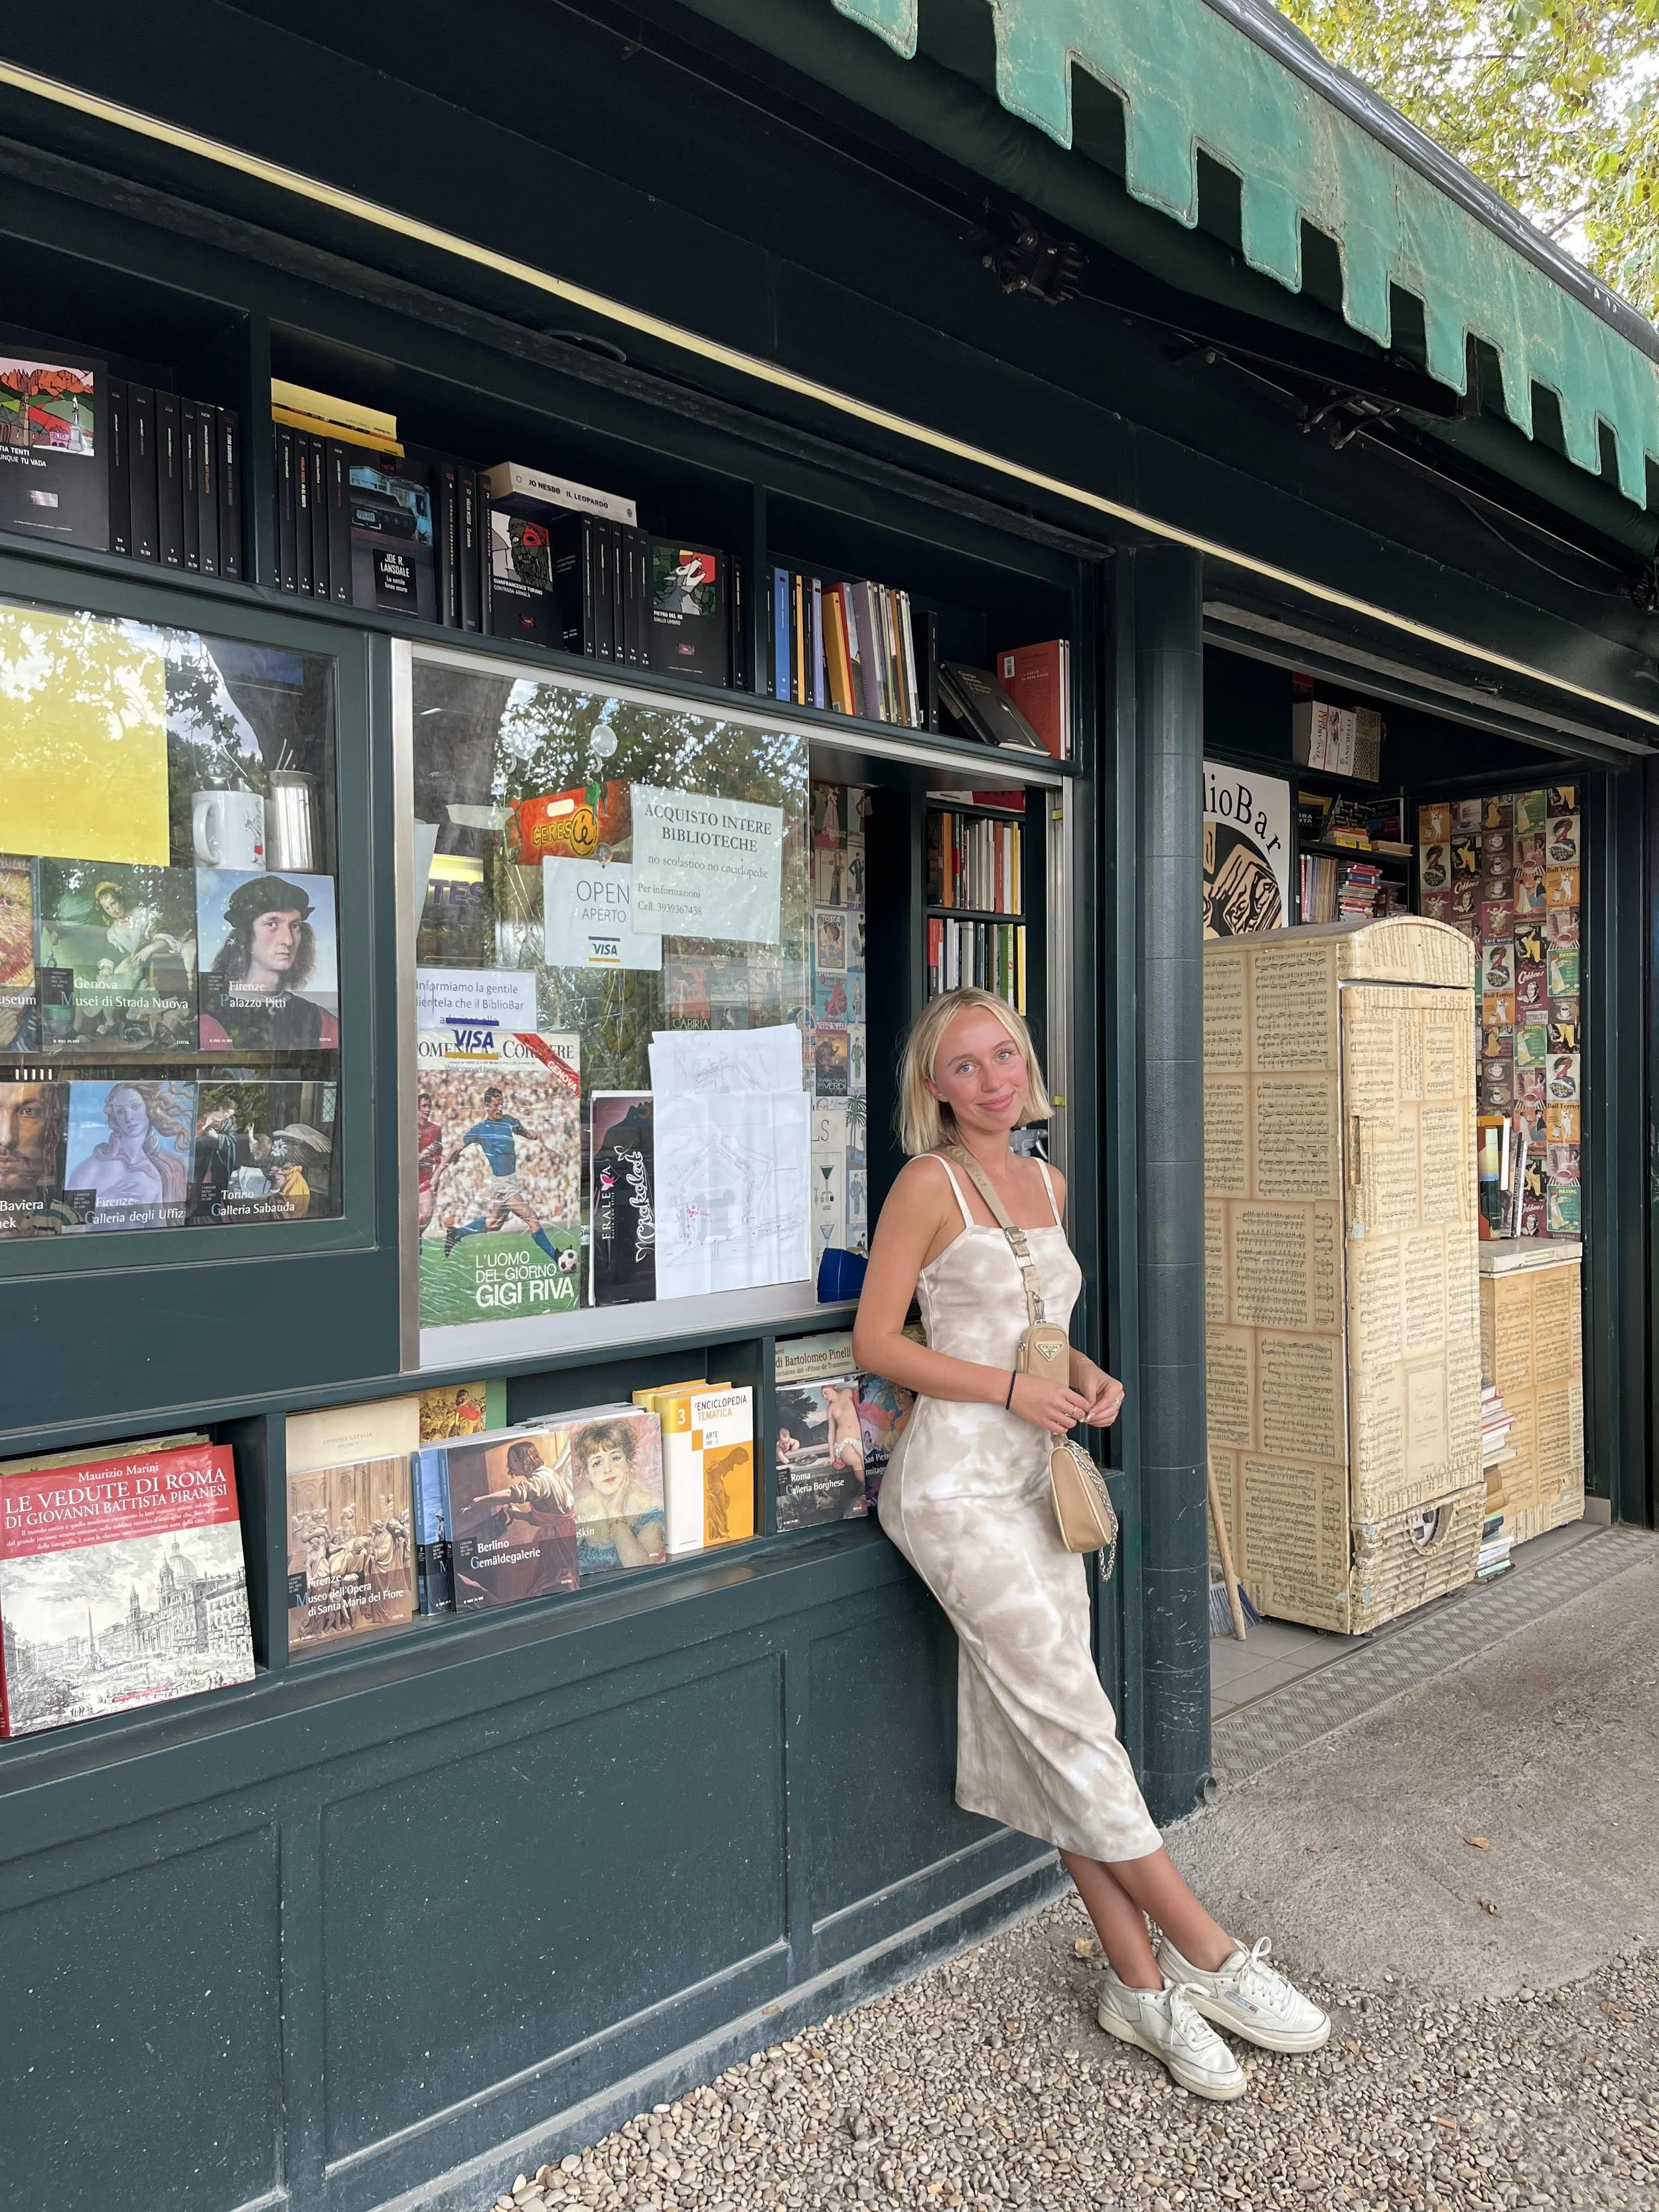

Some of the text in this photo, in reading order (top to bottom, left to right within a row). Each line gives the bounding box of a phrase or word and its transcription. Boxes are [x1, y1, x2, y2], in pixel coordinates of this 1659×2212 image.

[11, 447, 30, 456] TENTI
[30, 459, 47, 467] VADA
[529, 479, 537, 488] JO
[538, 480, 561, 495] NESBØ
[573, 492, 609, 509] LEOPARDO
[384, 553, 404, 565] JOE R.
[380, 562, 410, 578] LANSDALE
[494, 578, 526, 591] GIANFRANCESCO
[644, 803, 772, 836] ACQUISTO INTERE
[533, 820, 572, 846] CERES
[662, 826, 758, 853] BIBLIOTECHE
[648, 856, 661, 865] no
[662, 855, 705, 871] scolastico
[576, 880, 630, 906] OPEN
[637, 883, 701, 899] Per informazioni
[1454, 881, 1480, 895] Coffee!
[581, 909, 626, 923] APERTO
[822, 914, 841, 923] TOSCA
[592, 943, 618, 956] VISA
[74, 979, 118, 990] Genova
[228, 980, 265, 992] Firenze
[1518, 971, 1545, 985] Coffee!
[476, 982, 484, 993] la
[486, 984, 518, 995] gentile
[60, 992, 188, 1009] Musei di Strada Nuova
[220, 994, 287, 1008] Palazzo Pitti
[455, 997, 472, 1008] che
[474, 999, 479, 1009] il
[482, 999, 524, 1011] BiblioBar
[672, 1018, 710, 1030] CABIRIA
[451, 1029, 494, 1049] VISA
[547, 1061, 577, 1092] GENOVA
[96, 1197, 134, 1208] Firenze
[220, 1189, 255, 1201] Torino
[1, 1200, 44, 1211] Baviera
[211, 1201, 295, 1217] Galleria Sabauda
[84, 1208, 187, 1226] Galleria degli Uffizi
[476, 1251, 530, 1268] L'UOMO
[476, 1263, 557, 1284] DEL GIORNO
[476, 1276, 575, 1308] GIGI RIVA
[776, 1347, 851, 1368] di Bartolomeo Pinelli
[677, 1408, 686, 1426] 3
[697, 1407, 733, 1422] TEMATICA
[865, 1455, 875, 1464] San
[78, 1461, 159, 1483] Maurizio Marini
[790, 1473, 811, 1483] Roma
[5, 1467, 227, 1514] LE VEDUTE DI ROMA
[786, 1479, 845, 1496] Galleria Borghese
[5, 1484, 228, 1529] DI GIOVANNI BATTISTA PIRANESI
[17, 1538, 35, 1547] grande
[477, 1540, 510, 1554] Berlino
[470, 1548, 541, 1570] Gemäldegalerie
[307, 1574, 342, 1589] Firenze
[296, 1583, 372, 1607] Museo dell'Opera
[308, 1589, 404, 1617] di Santa Maria del Fiore
